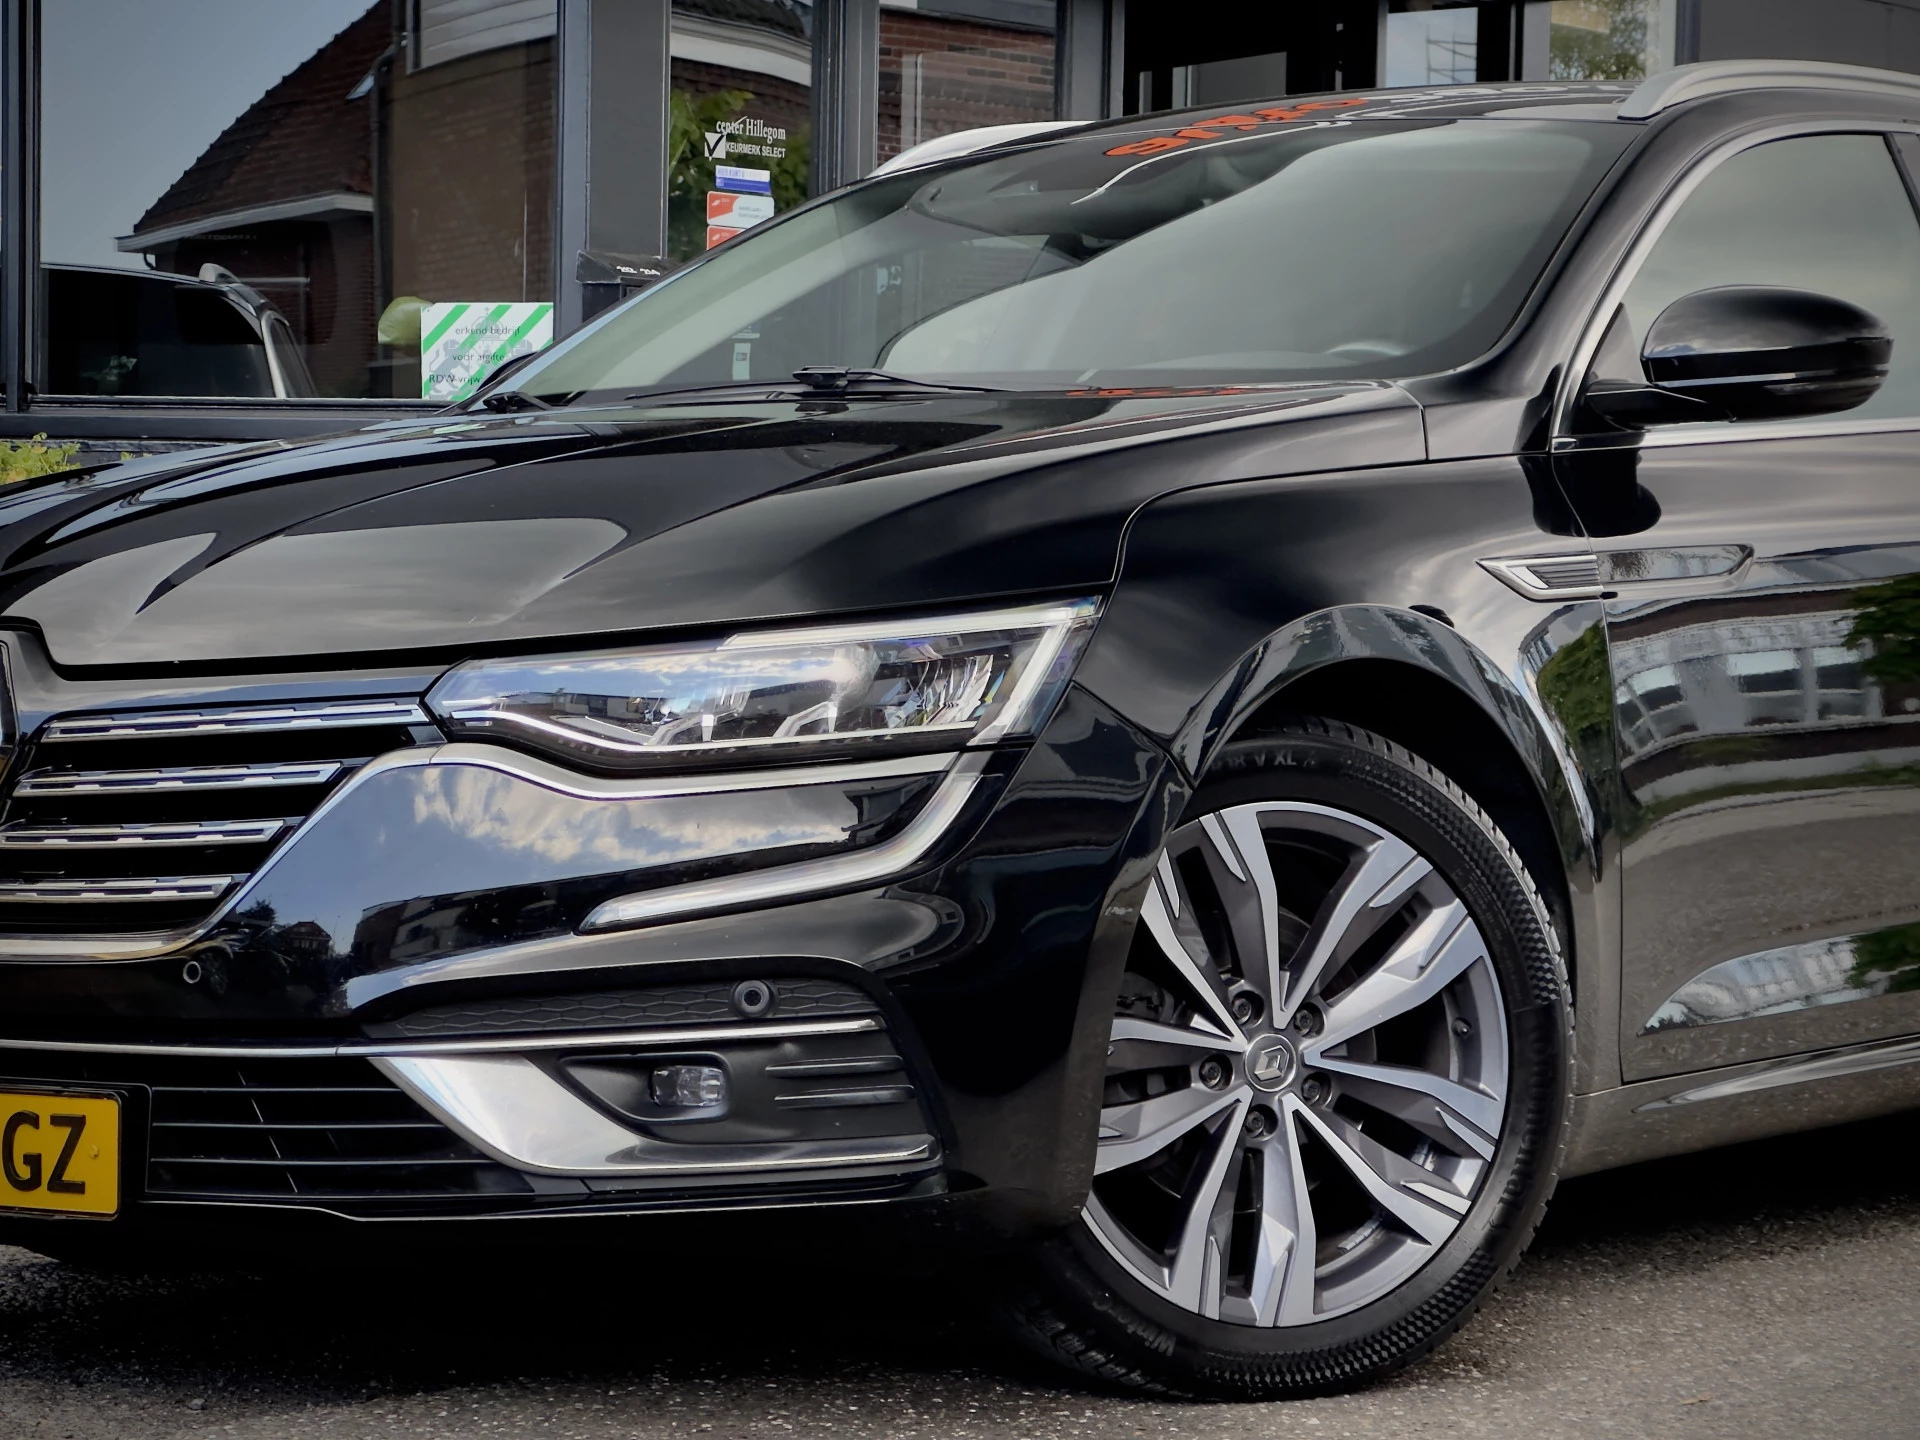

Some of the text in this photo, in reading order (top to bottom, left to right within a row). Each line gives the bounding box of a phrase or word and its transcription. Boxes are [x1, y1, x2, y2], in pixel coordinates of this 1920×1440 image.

[717, 119, 786, 143] center Hillegom
[726, 142, 786, 158] KEURMERK SELECT
[455, 326, 521, 337] erkend bedrijf
[477, 352, 505, 364] afgifte
[429, 374, 481, 386] RDW-vrijw
[1273, 749, 1297, 766] XL
[1, 1109, 87, 1195] GZ
